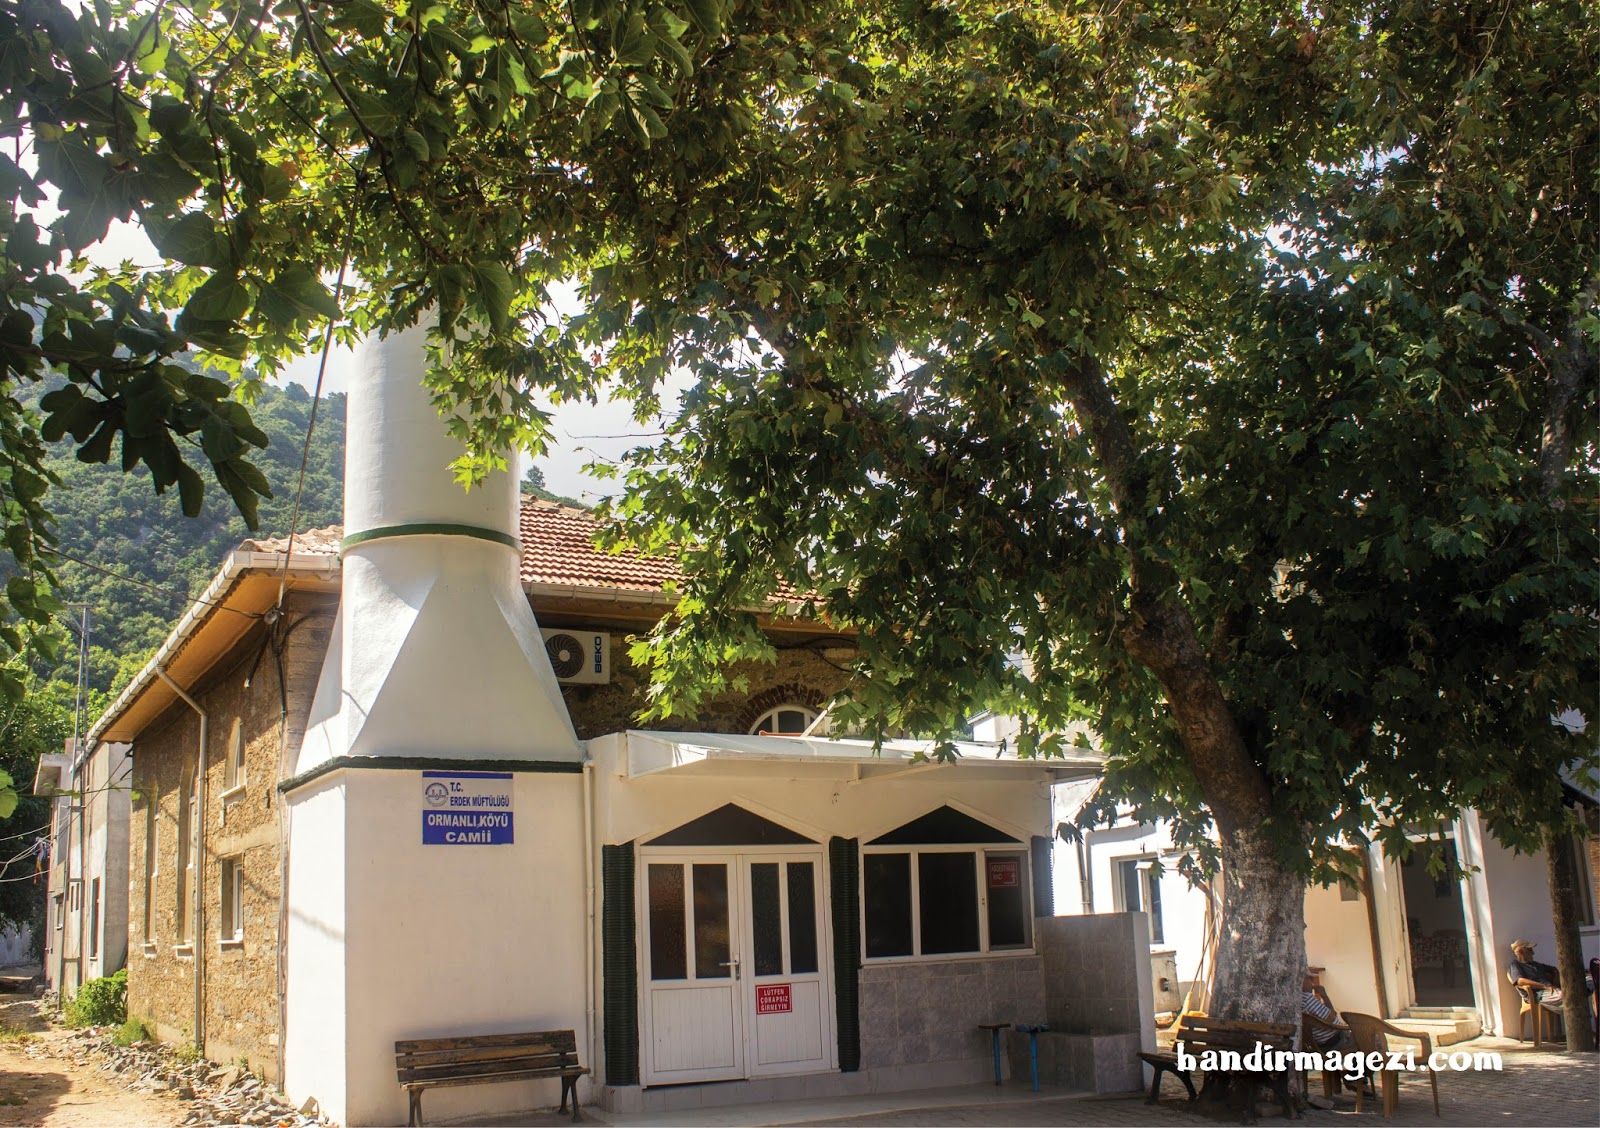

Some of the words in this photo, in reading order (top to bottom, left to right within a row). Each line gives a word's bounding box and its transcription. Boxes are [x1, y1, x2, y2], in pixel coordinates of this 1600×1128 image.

[594, 636, 602, 673] BEKO
[450, 782, 464, 792] T.C.
[450, 796, 471, 807] ERDEK
[472, 795, 510, 807] MÜFTÜLÜĞÜ
[427, 813, 477, 828] ORMANLI
[478, 812, 509, 828] KÖYÜ
[763, 988, 784, 996] LÜTFEN
